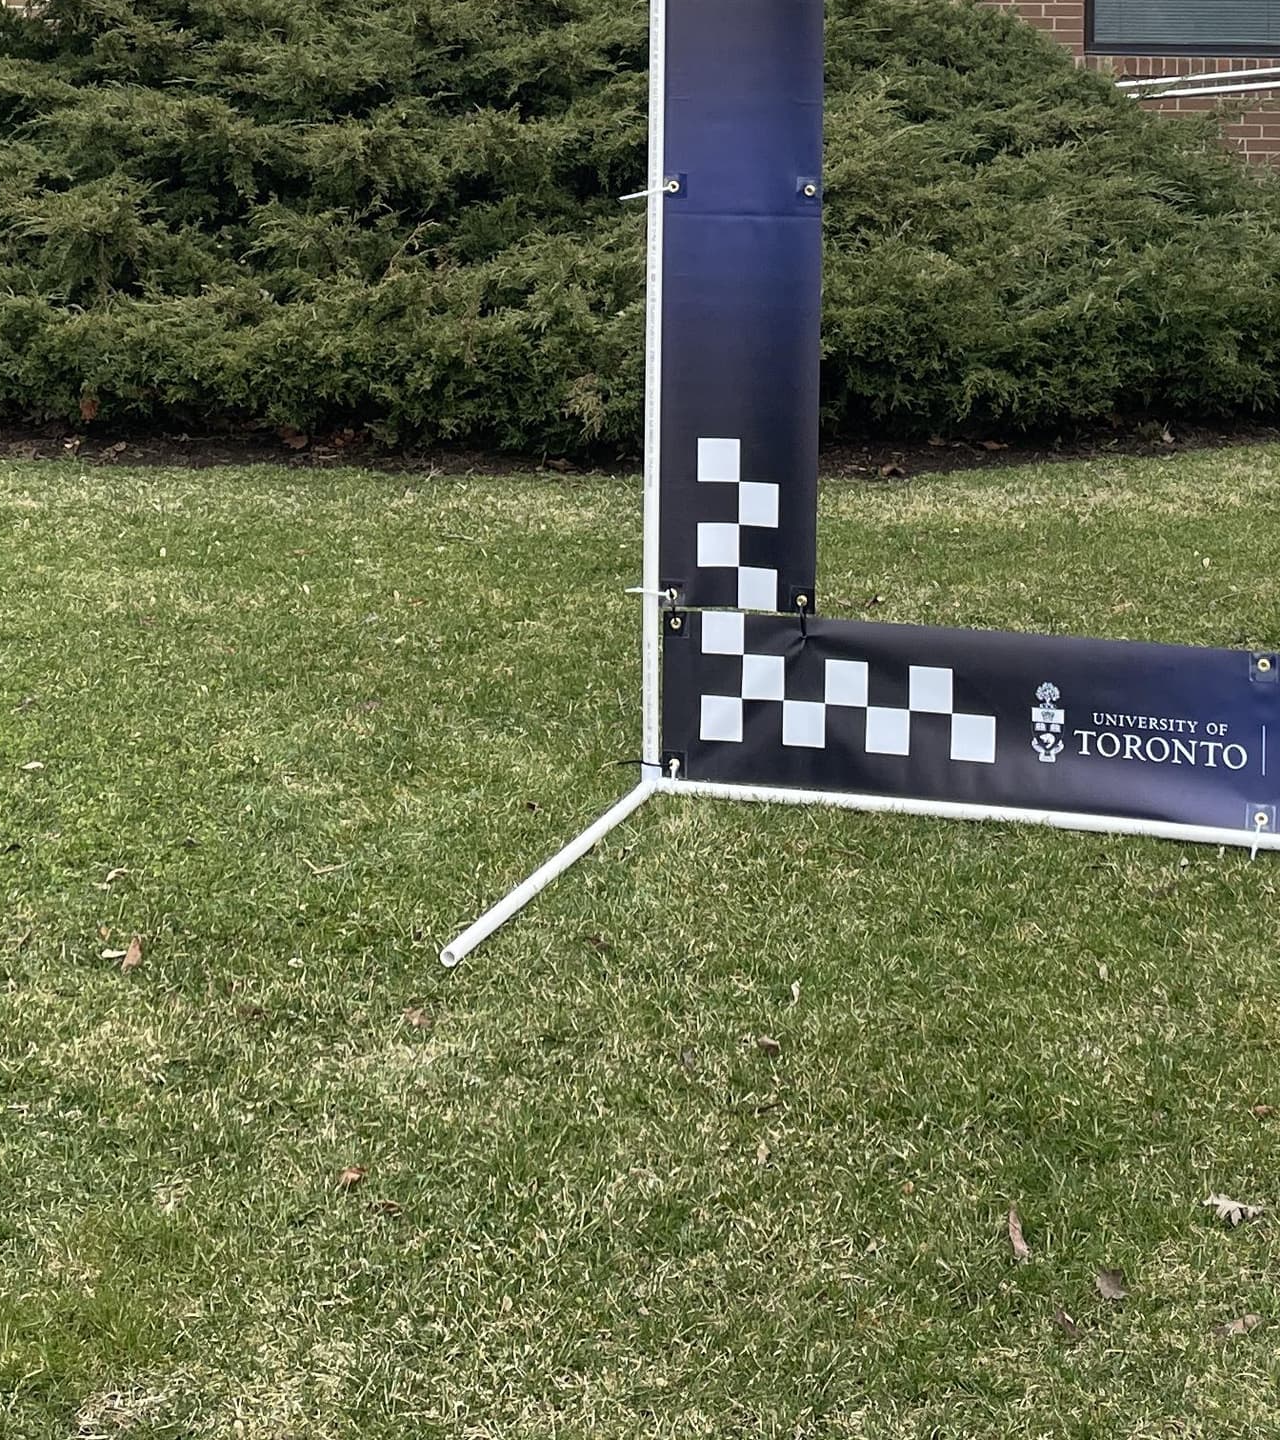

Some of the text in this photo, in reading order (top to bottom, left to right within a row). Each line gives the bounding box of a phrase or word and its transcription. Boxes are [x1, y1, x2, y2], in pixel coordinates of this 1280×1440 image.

[1093, 712, 1229, 736] UNIVERSITY OF
[1073, 729, 1248, 770] TORONTO
